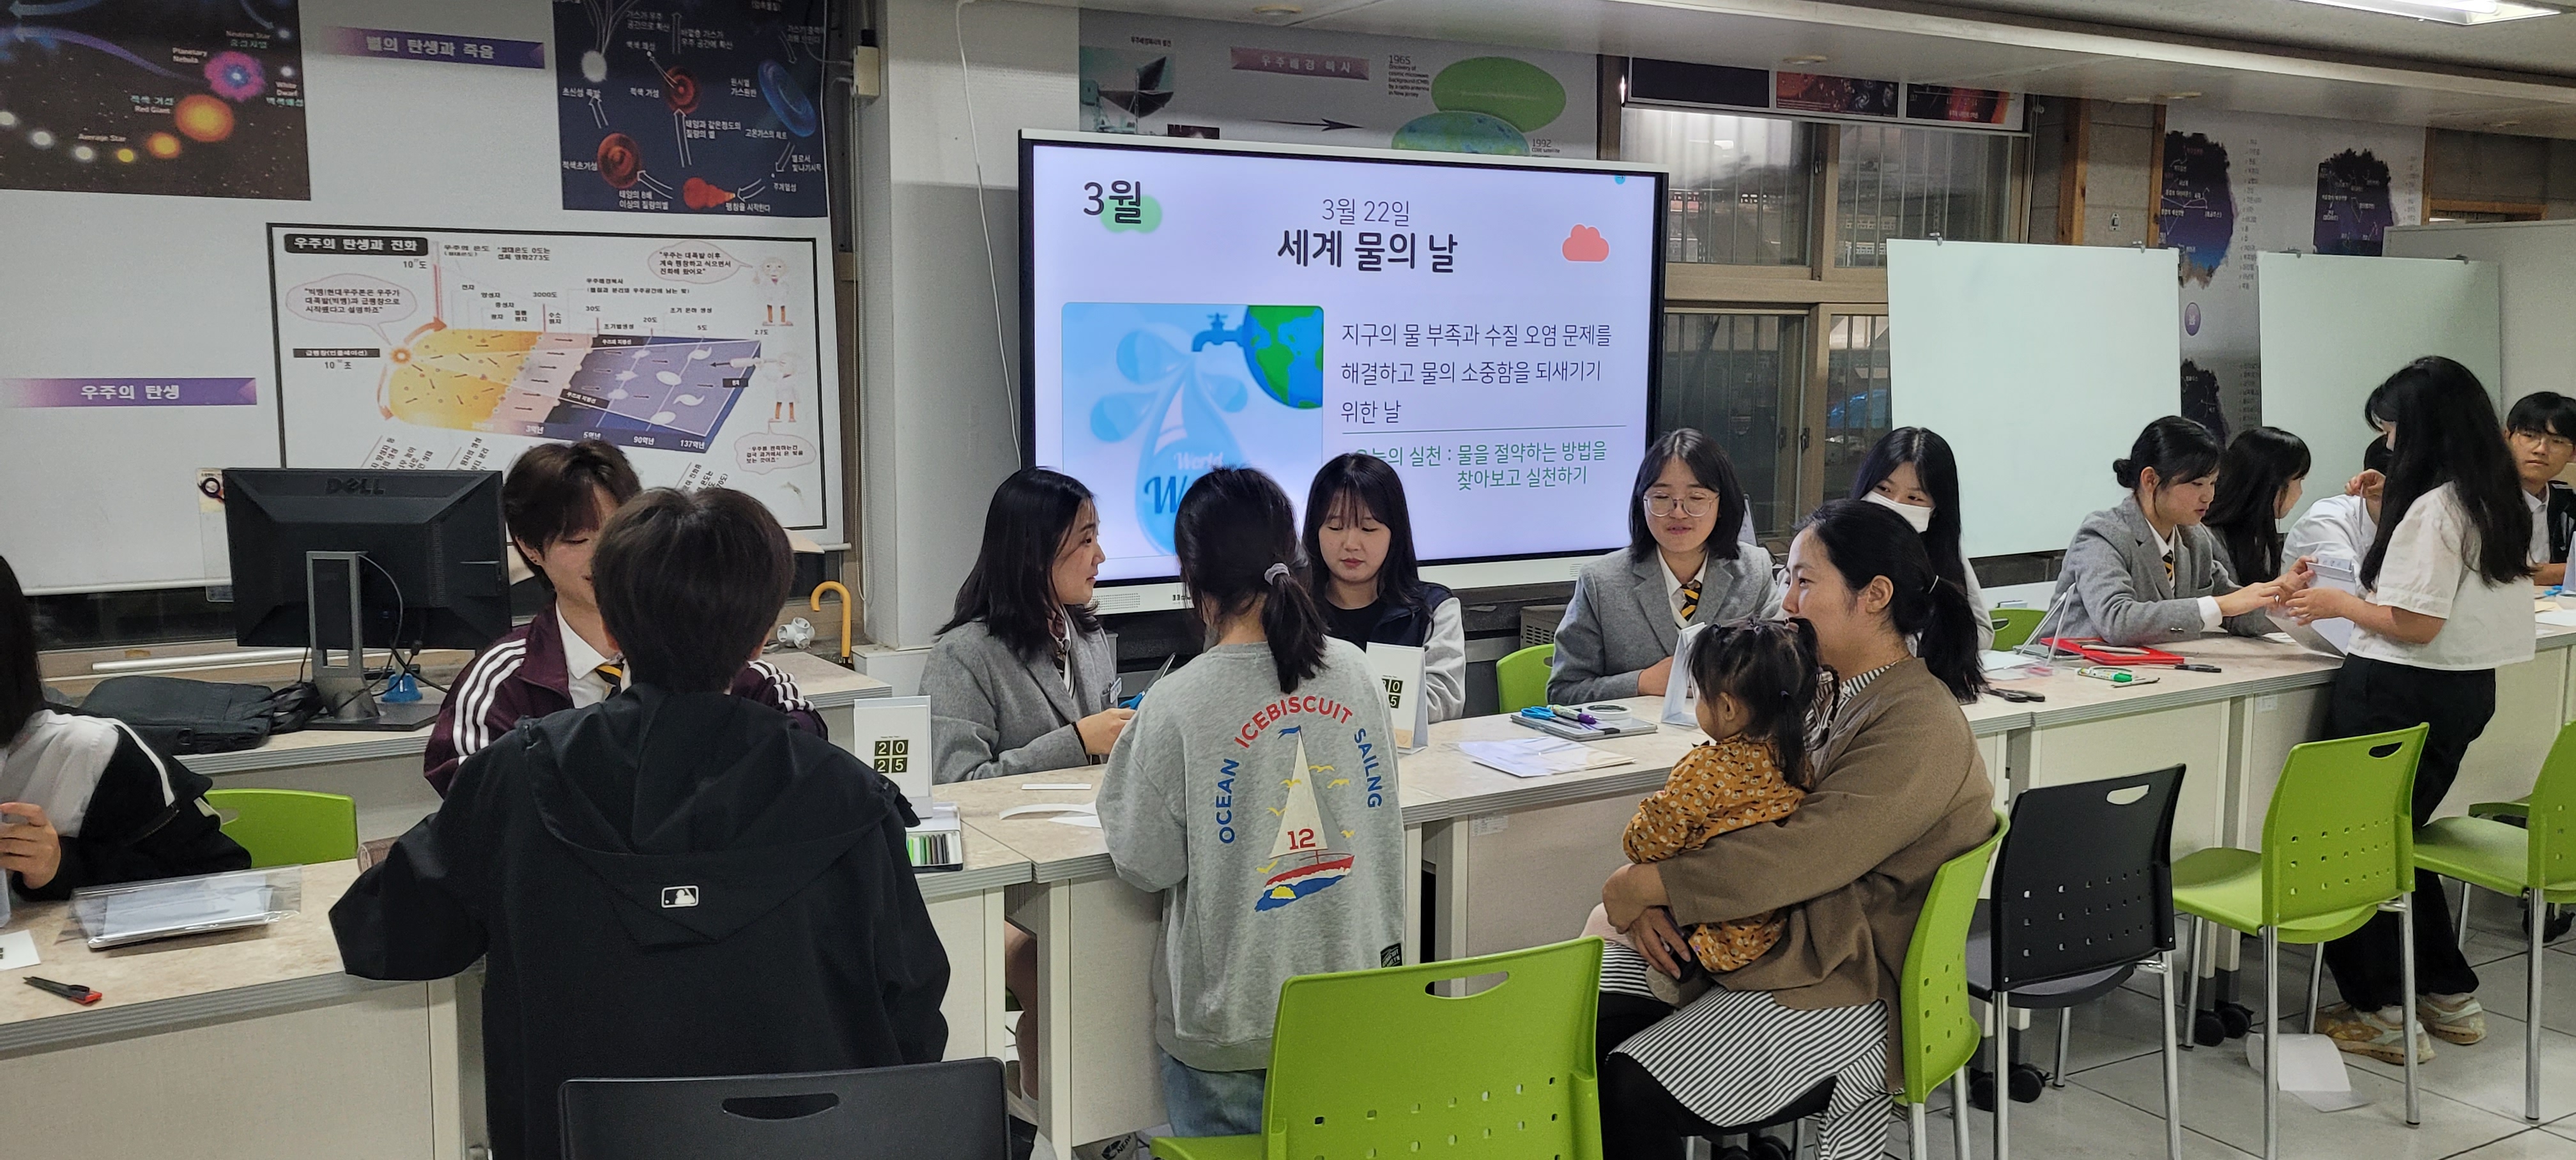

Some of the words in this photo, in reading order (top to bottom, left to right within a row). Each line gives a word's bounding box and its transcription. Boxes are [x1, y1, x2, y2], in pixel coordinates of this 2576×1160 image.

[367, 36, 398, 52] 별의
[407, 39, 456, 56] 탄생과
[463, 43, 494, 59] 죽음
[1389, 55, 1411, 65] 1965
[562, 87, 583, 97] 초신성
[645, 89, 659, 98] 거성
[1533, 139, 1551, 148] 1992
[1084, 179, 1142, 225] 3월
[1322, 198, 1355, 225] 3월
[1364, 201, 1409, 227] 22일
[294, 237, 335, 249] 우주의
[342, 239, 383, 251] 탄생과
[390, 240, 418, 252] 진화
[1277, 229, 1342, 267] 세계
[1354, 232, 1416, 272] 물의
[1429, 233, 1459, 273] 날
[1342, 323, 1397, 347] 지구의
[1403, 324, 1421, 347] 물
[1426, 323, 1480, 347] 부족과
[1484, 324, 1518, 347] 수질
[1524, 324, 1557, 347] 오염
[1562, 324, 1612, 347] 문제를
[1341, 362, 1415, 385] 해결하고
[1420, 362, 1455, 385] 물의
[1460, 361, 1530, 385] 소중함을
[1535, 360, 1602, 382] 되새기기
[80, 385, 135, 400] 우주의
[145, 385, 180, 399] 탄생
[1341, 400, 1378, 424] 위한
[1384, 400, 1402, 424] 날
[526, 425, 544, 435] 3억년
[583, 431, 601, 441] 5억년
[633, 436, 655, 446] 90억년
[680, 439, 705, 449] 137억년
[1174, 452, 1224, 469] World
[1409, 445, 1442, 467] 실천
[1457, 444, 1489, 466] 물을
[1494, 442, 1557, 464] 절약하는
[1561, 440, 1607, 461] 방법을
[325, 477, 385, 494] DELL
[1457, 469, 1521, 491] 찾아보고
[1526, 466, 1587, 488] 실천하기
[878, 741, 905, 754] 20
[877, 759, 904, 772] 25
[1215, 758, 1240, 844] OCEAN
[1234, 695, 1353, 749] ICEBISCUIT
[1353, 727, 1383, 809] SAILNG
[1287, 828, 1317, 850] 12
